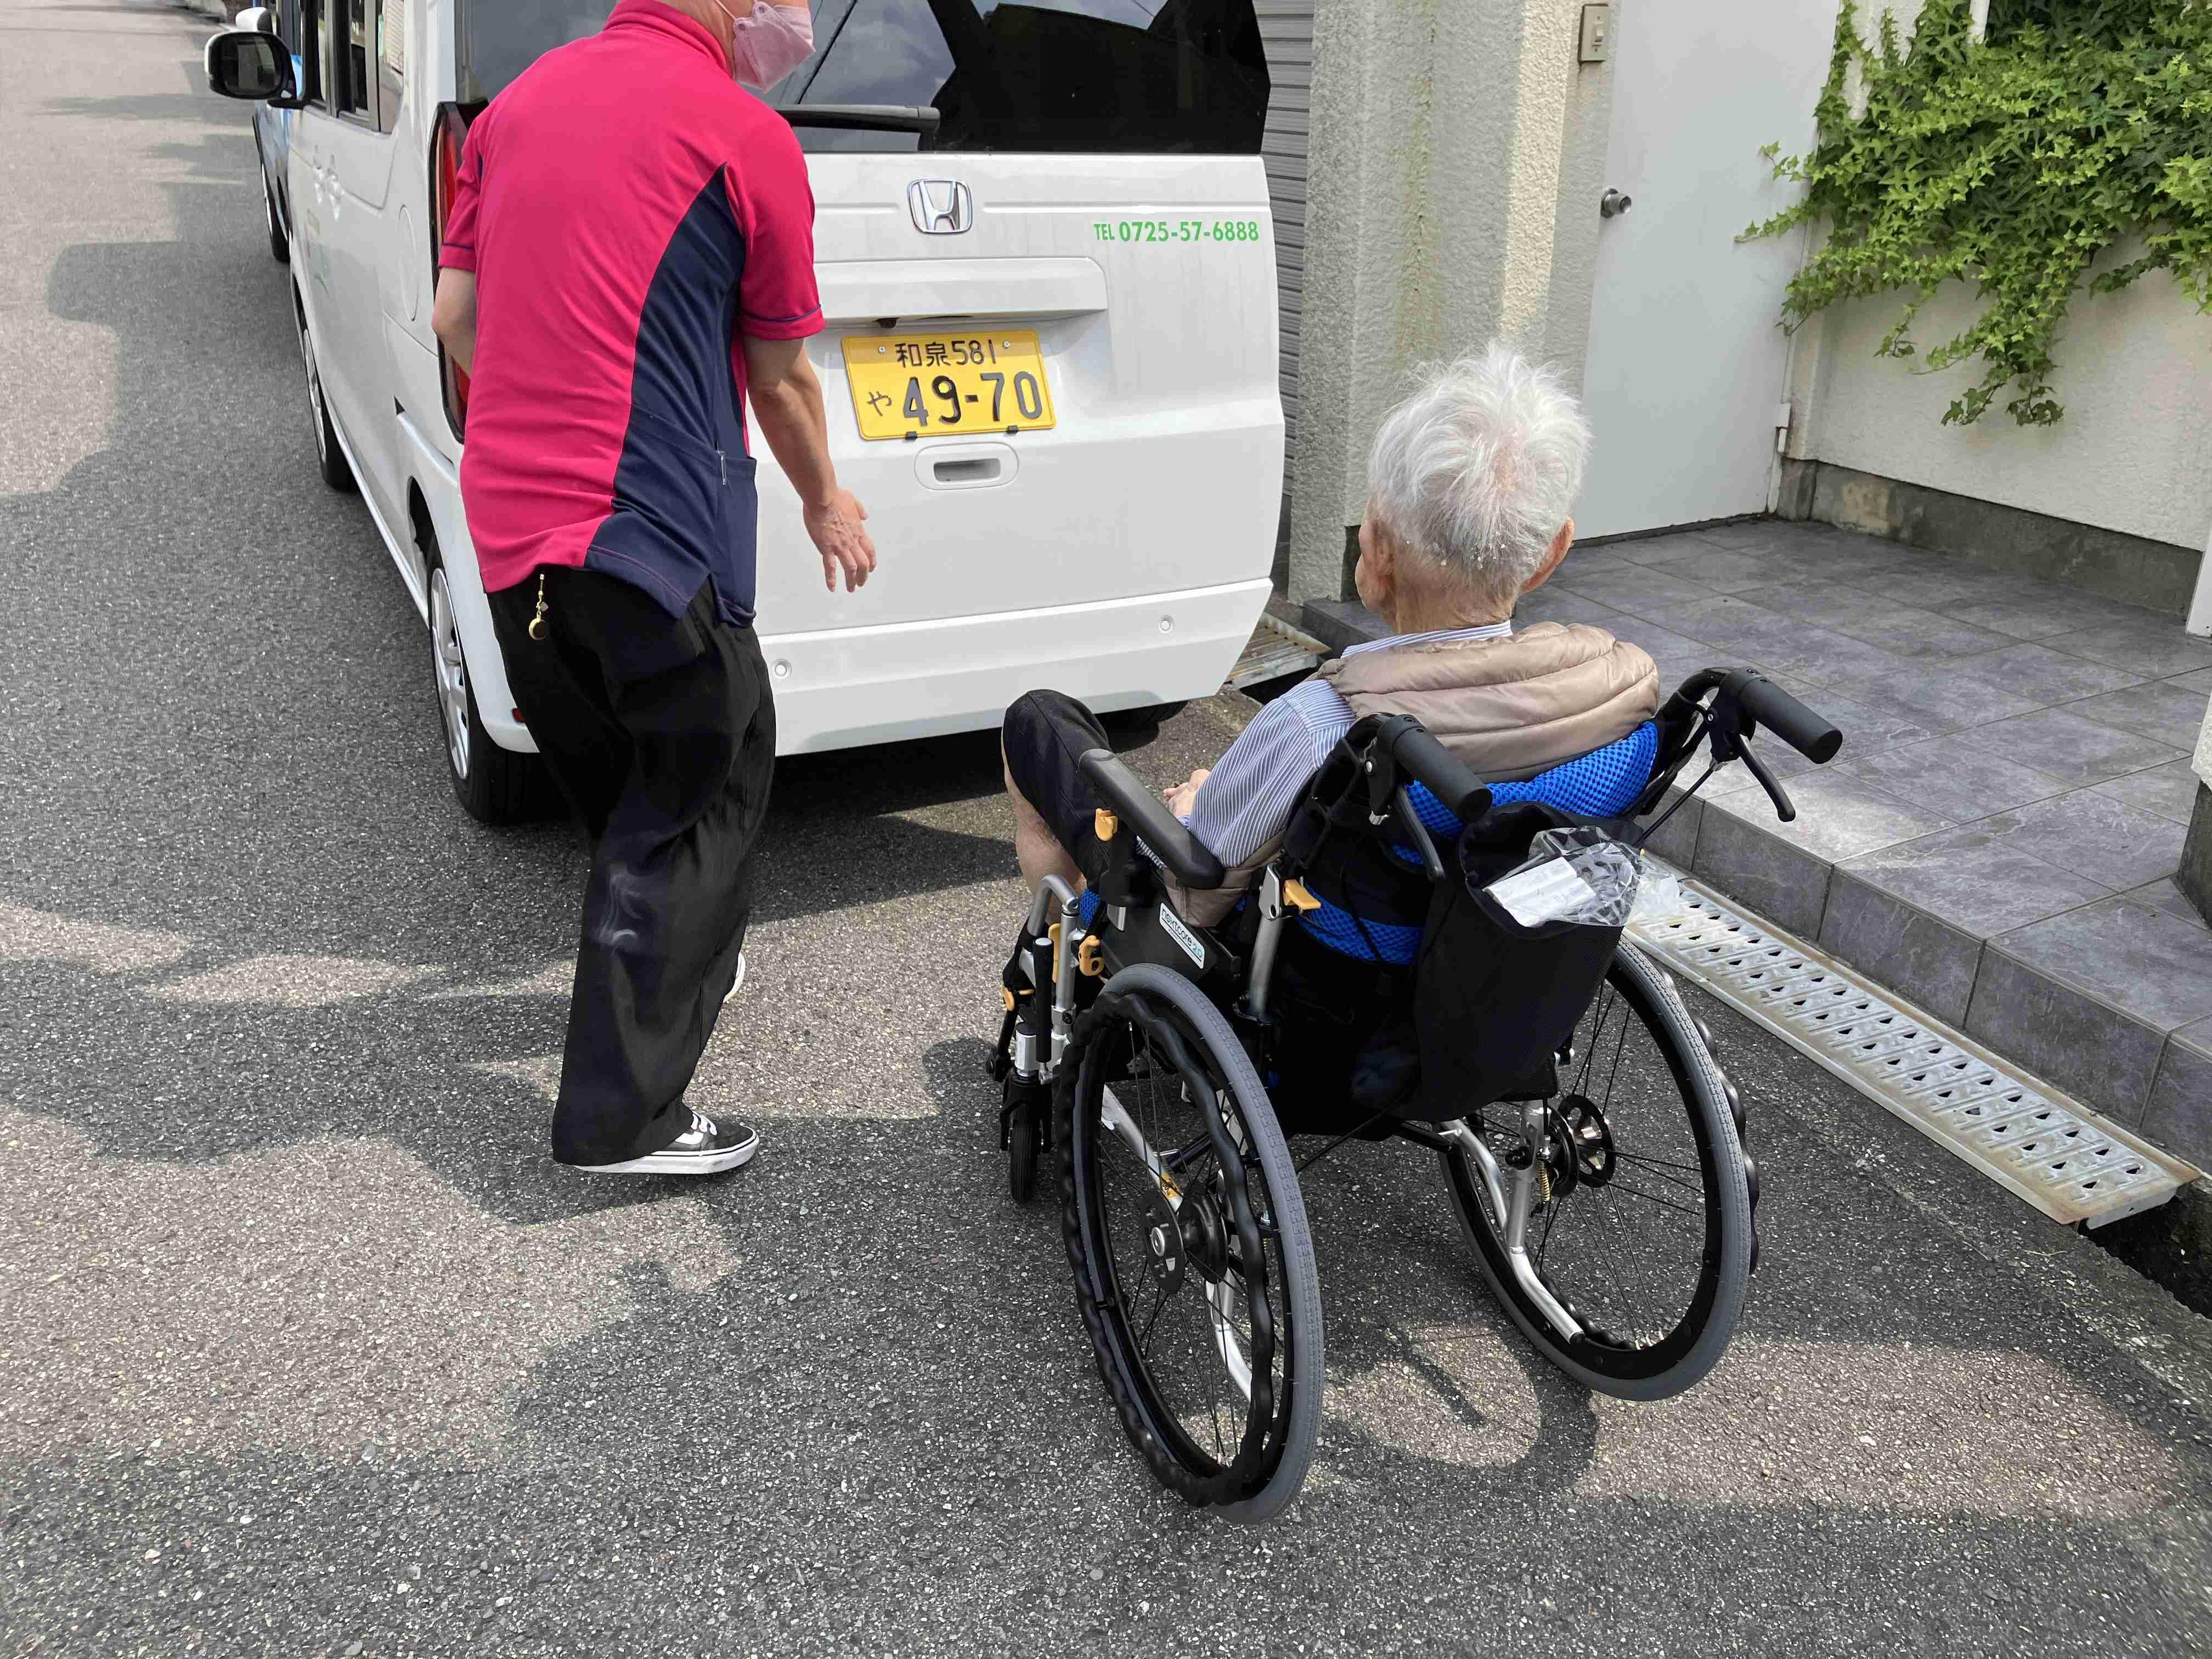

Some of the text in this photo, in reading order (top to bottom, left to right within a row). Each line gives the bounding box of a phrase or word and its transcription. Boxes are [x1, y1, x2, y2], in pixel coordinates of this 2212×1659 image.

[1093, 221, 1260, 242] TEL 0725-57-6888
[867, 370, 1043, 427] や 49-70
